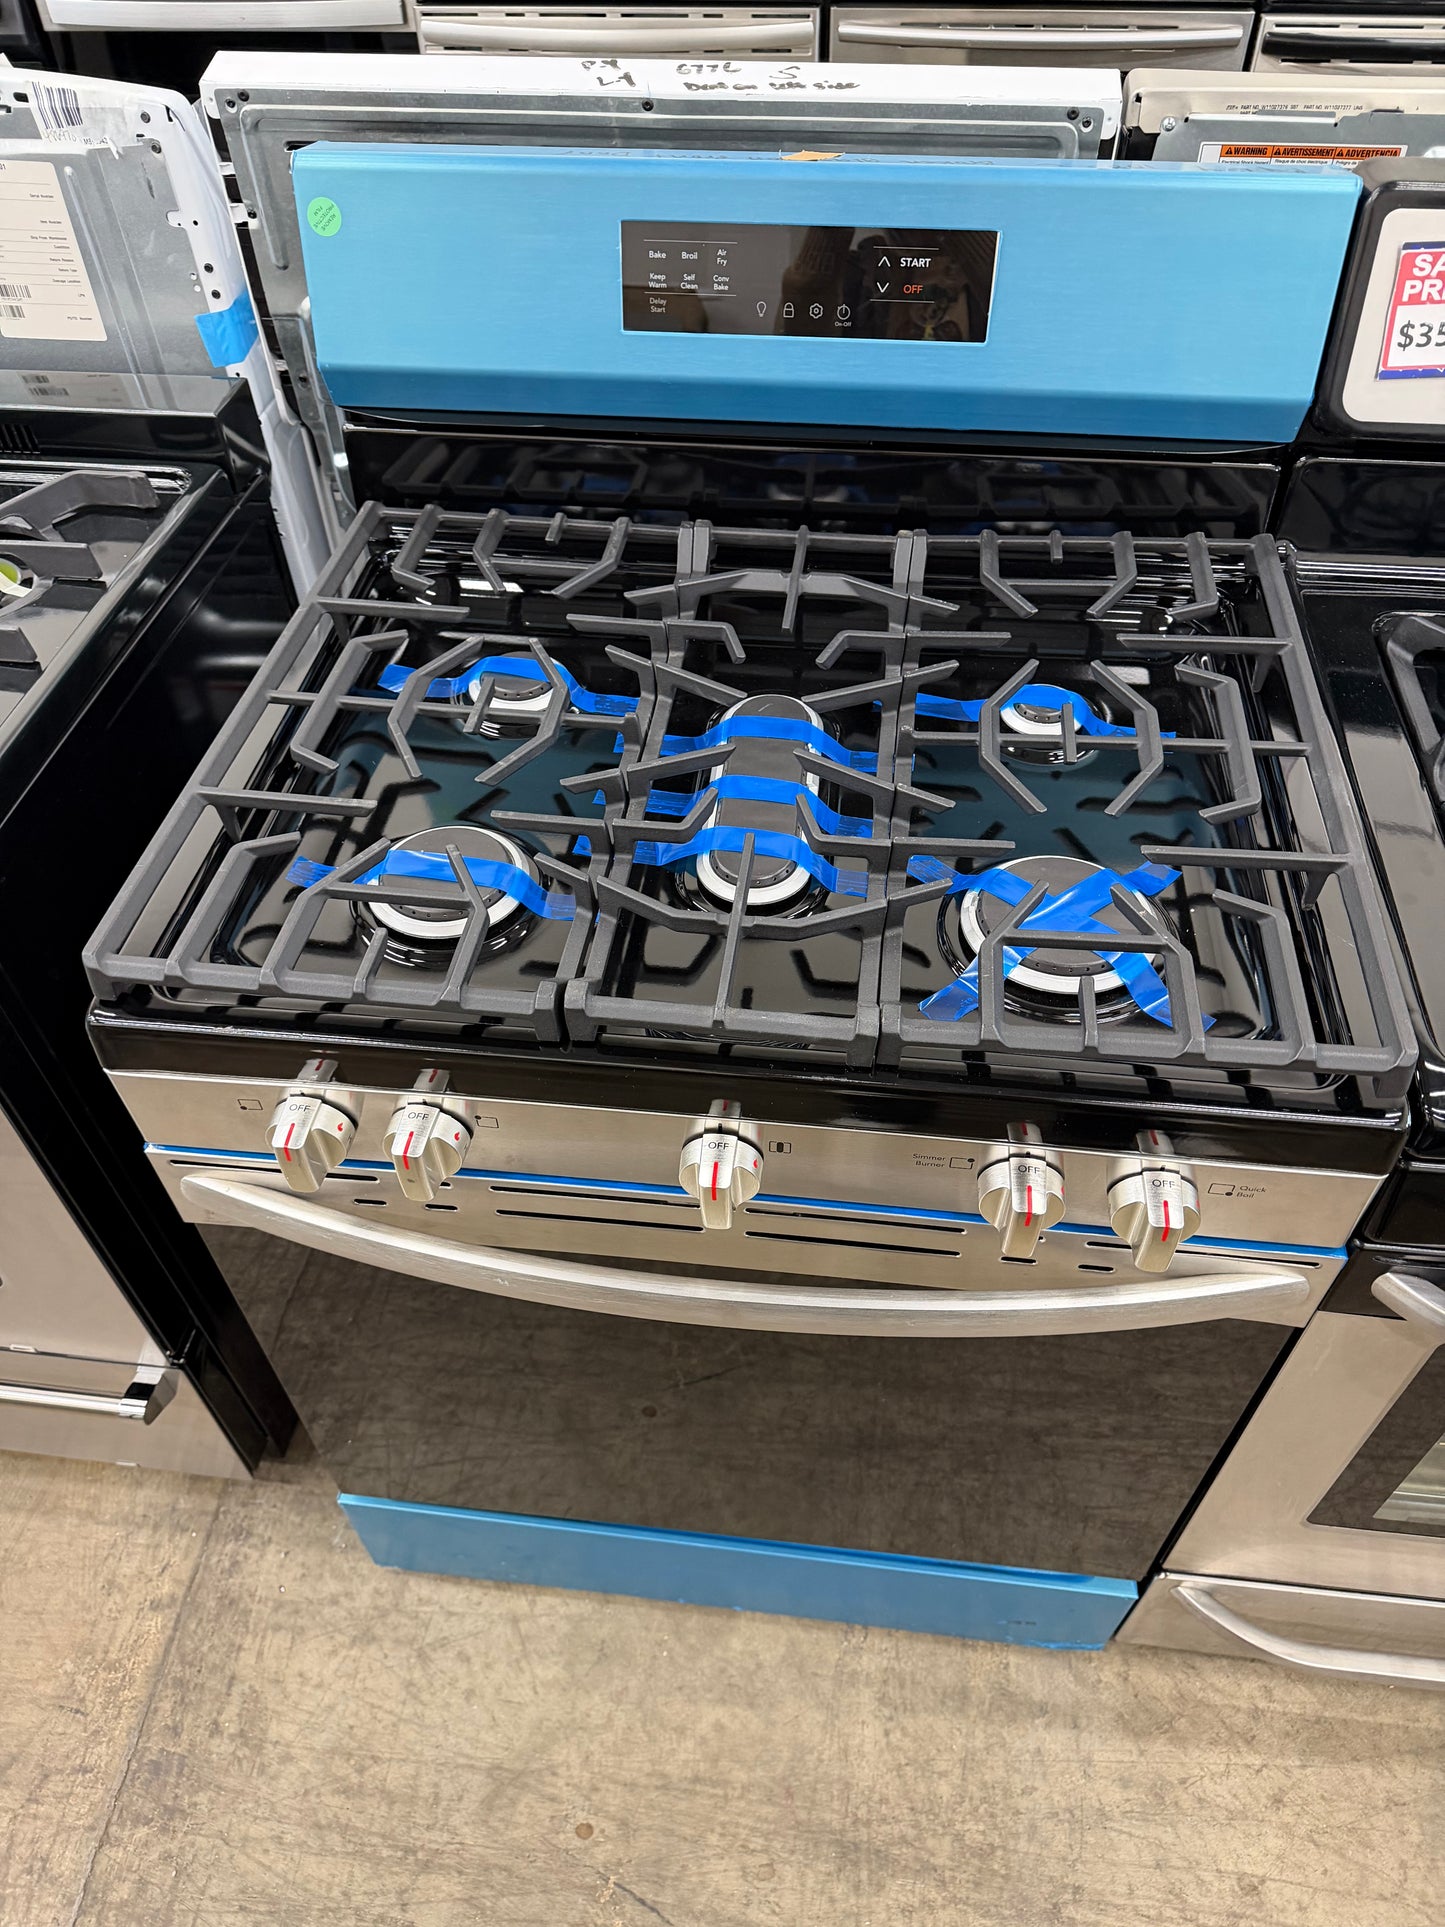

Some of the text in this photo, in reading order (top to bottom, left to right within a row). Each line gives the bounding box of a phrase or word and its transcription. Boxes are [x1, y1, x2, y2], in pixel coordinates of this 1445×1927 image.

[1233, 146, 1268, 156] WARNING
[1281, 147, 1335, 157] AVERTISSEMENT
[1344, 148, 1398, 158] ADVERTENCIA
[648, 250, 667, 259] Bake
[681, 251, 698, 260] Broil
[716, 248, 727, 256] Air
[716, 257, 727, 267] Fry
[900, 257, 931, 268] START
[649, 272, 666, 281] Keep
[683, 273, 696, 281] Self
[712, 274, 730, 282] Conv
[648, 281, 668, 289] Warm
[680, 282, 699, 290] Clean
[713, 283, 729, 291] Bake
[903, 284, 923, 294] OFF
[649, 297, 667, 306] Delay
[289, 1103, 311, 1113] OFF
[407, 1112, 429, 1121] OFF
[708, 1141, 729, 1150] OFF
[912, 1153, 946, 1161] Simmer
[1017, 1165, 1040, 1174] OFF
[1152, 1179, 1176, 1188] OFF
[1239, 1185, 1267, 1193] Quick
